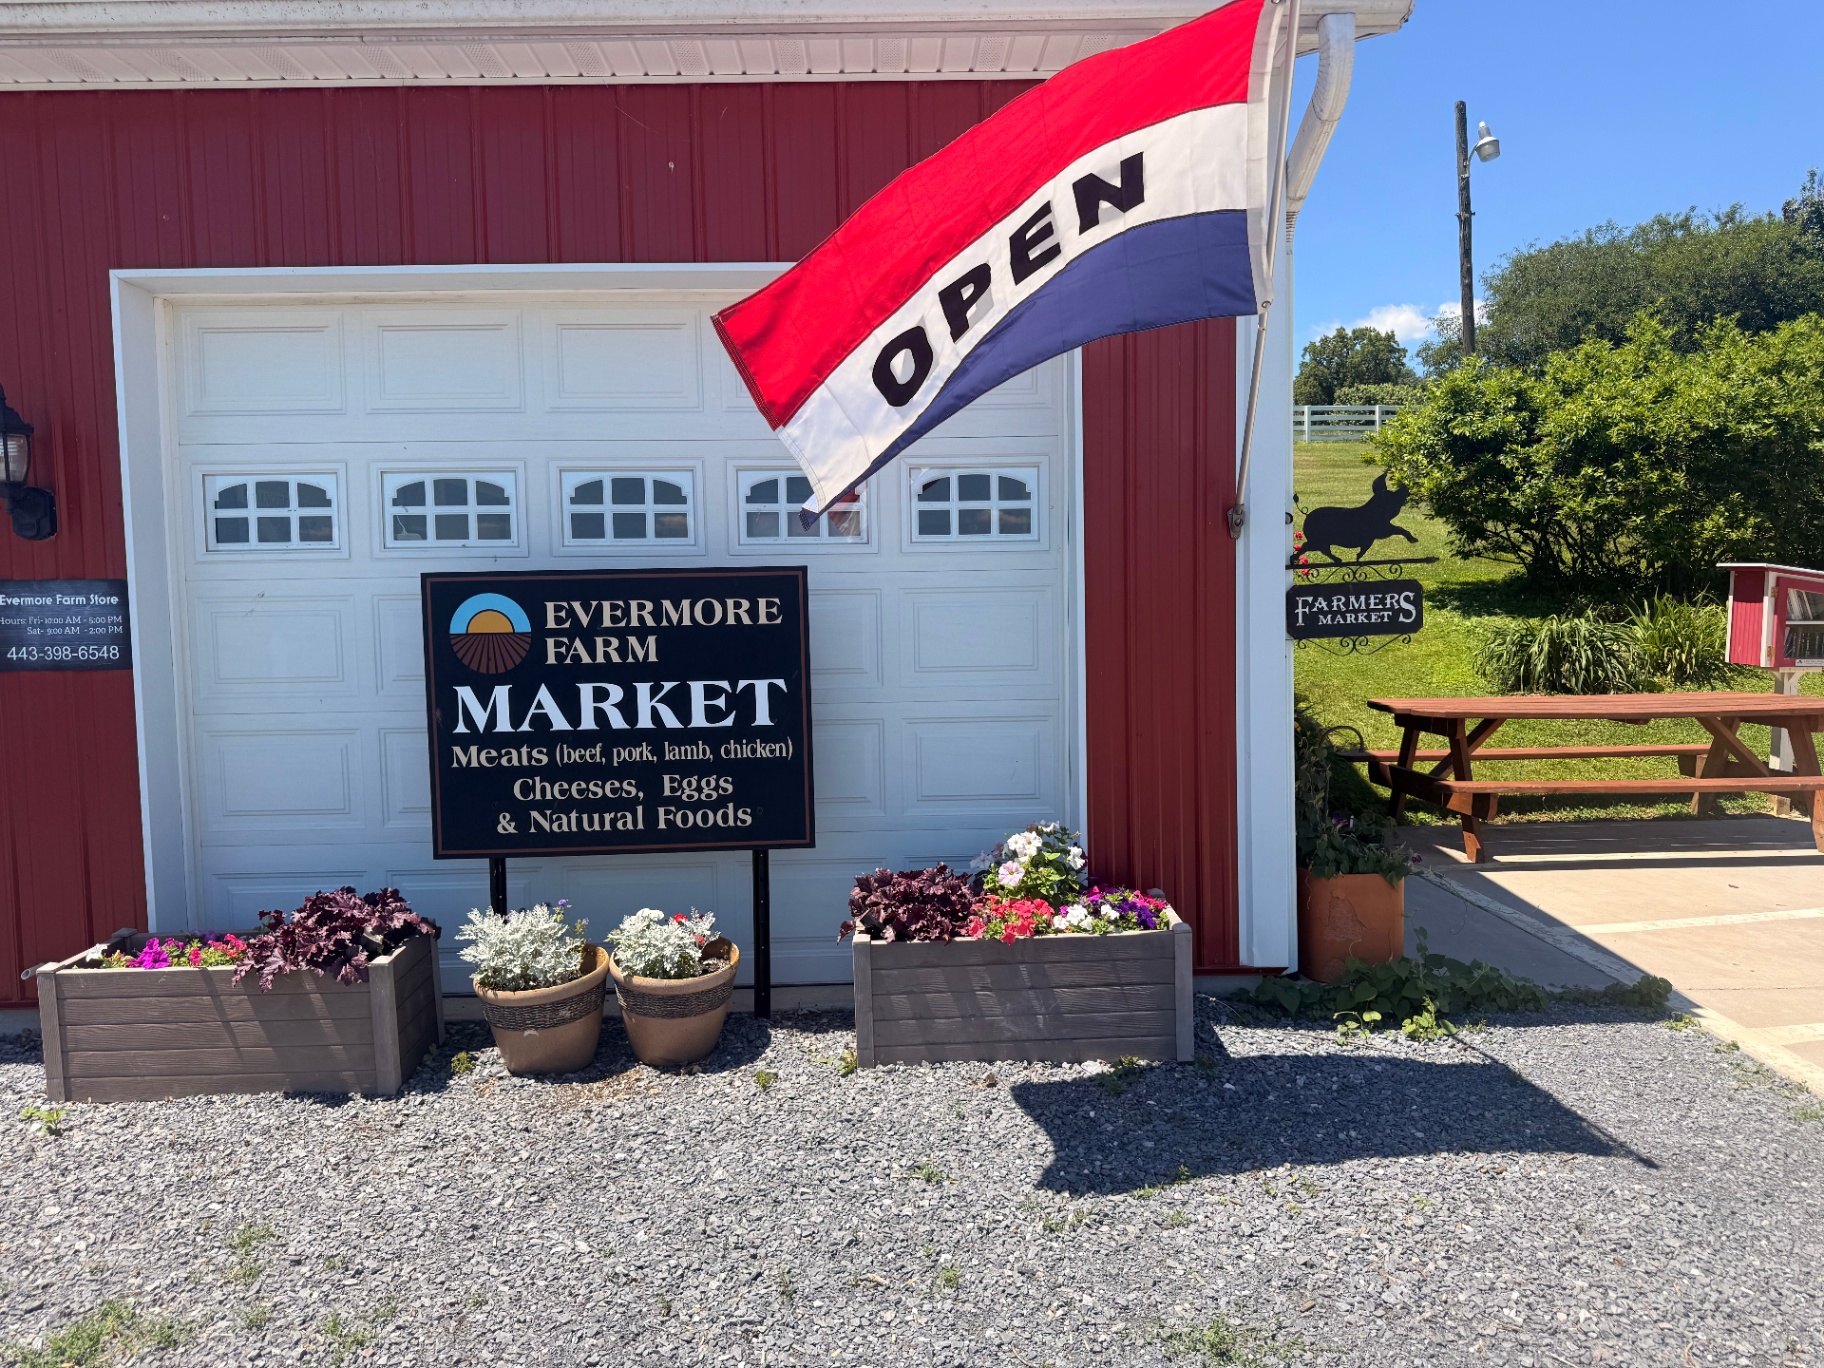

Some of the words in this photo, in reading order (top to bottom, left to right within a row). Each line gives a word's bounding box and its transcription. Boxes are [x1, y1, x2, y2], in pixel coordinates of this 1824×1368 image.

[872, 151, 1145, 407] OPEN
[0, 594, 52, 605] Evermore
[56, 594, 86, 605] Farm
[90, 593, 119, 605] Store
[544, 597, 783, 629] EVERMORE
[1294, 591, 1417, 626] FARMERS
[64, 626, 80, 635] AM
[107, 625, 123, 634] PM
[65, 616, 81, 624] AM
[107, 615, 123, 624] PM
[1318, 611, 1392, 625] MARKET
[7, 645, 120, 661] 443-398-6548
[544, 635, 659, 665] FARM
[452, 678, 788, 734] MARKET
[451, 744, 548, 768] Meats
[555, 742, 606, 768] (beef,
[612, 740, 657, 767] pork,
[664, 739, 714, 763] lamb,
[720, 736, 794, 761] chicken)
[513, 776, 645, 802] Cheeses,
[662, 774, 734, 802] Eggs
[497, 812, 518, 834] &
[529, 805, 645, 833] Natural
[656, 803, 753, 830] Foods
